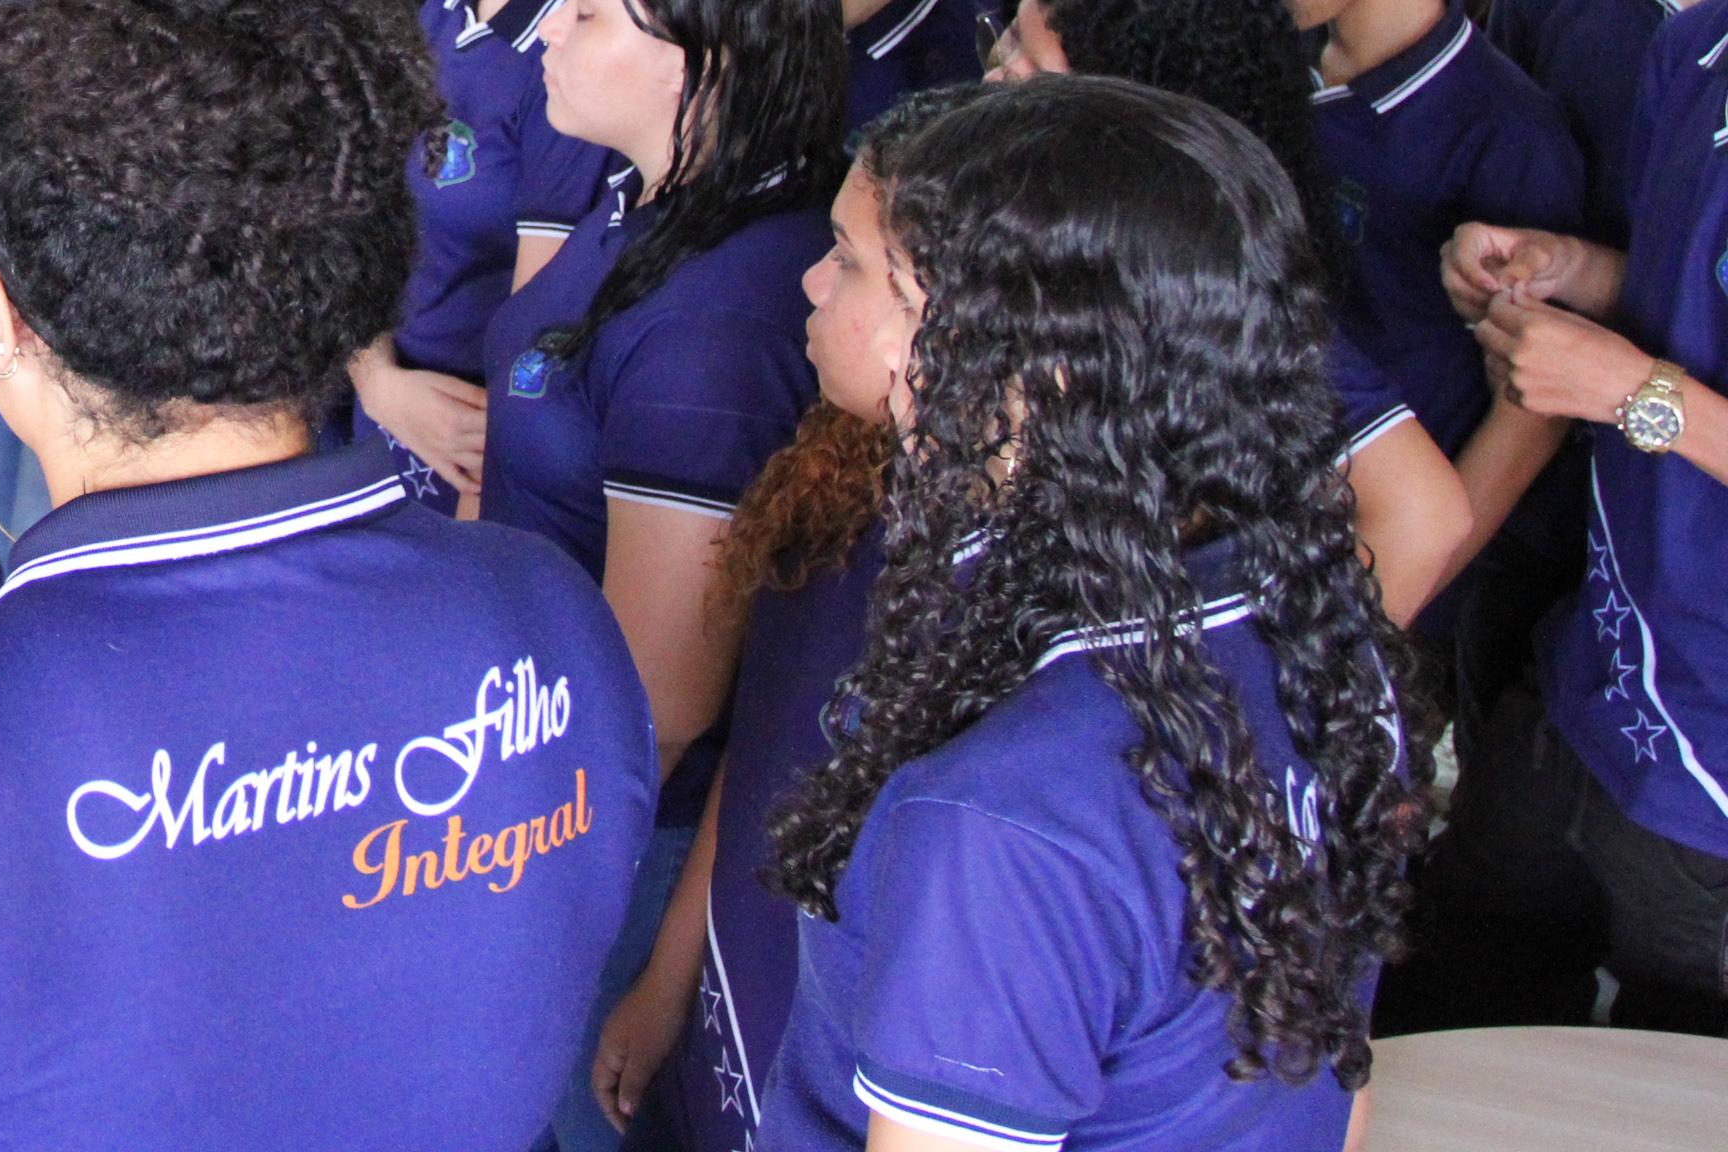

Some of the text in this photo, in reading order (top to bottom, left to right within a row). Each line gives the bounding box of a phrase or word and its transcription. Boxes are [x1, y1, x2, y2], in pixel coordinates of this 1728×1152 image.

[67, 655, 571, 860] Martins Filho
[341, 767, 594, 911] Integral
